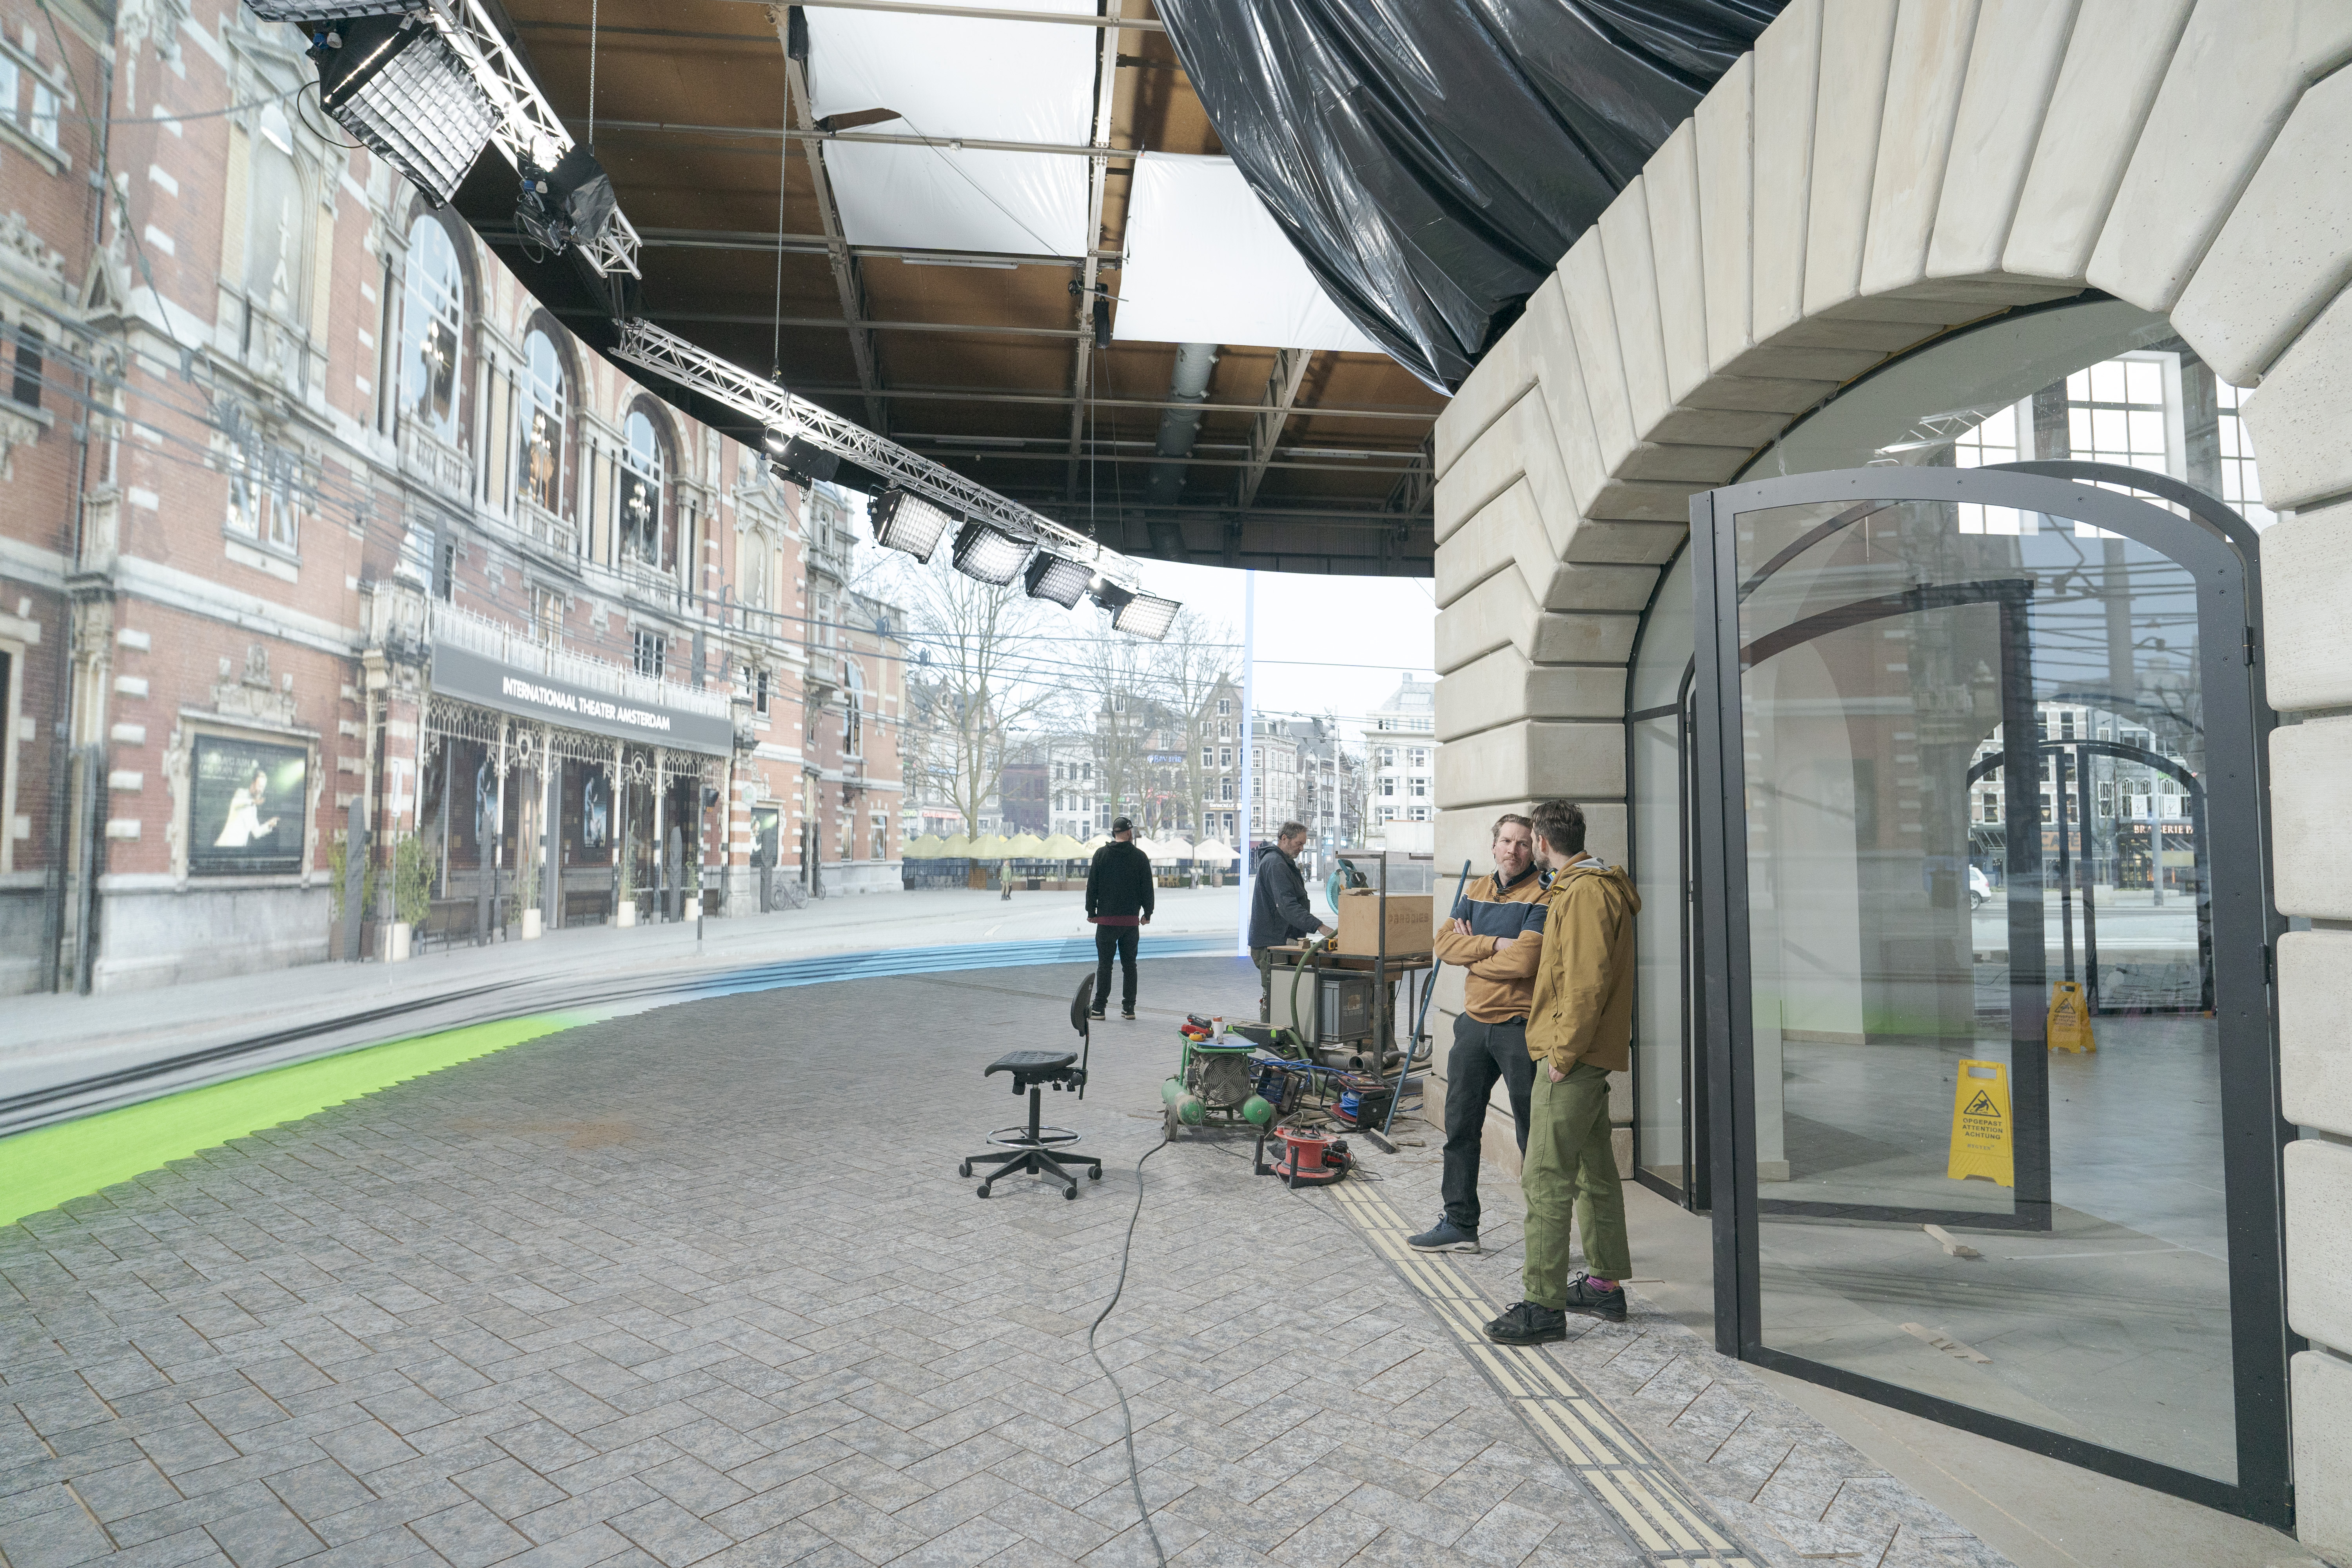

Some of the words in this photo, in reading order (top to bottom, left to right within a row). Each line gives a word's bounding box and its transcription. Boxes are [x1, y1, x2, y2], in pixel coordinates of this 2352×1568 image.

[503, 677, 577, 712] INTERNATIONAAL
[578, 697, 616, 720] THEATER
[617, 706, 671, 731] AMSTERDAM
[1963, 1118, 2002, 1126] OPGEPAST
[1962, 1125, 2003, 1133] ATTENTION
[1965, 1131, 2000, 1140] ACHTUNG
